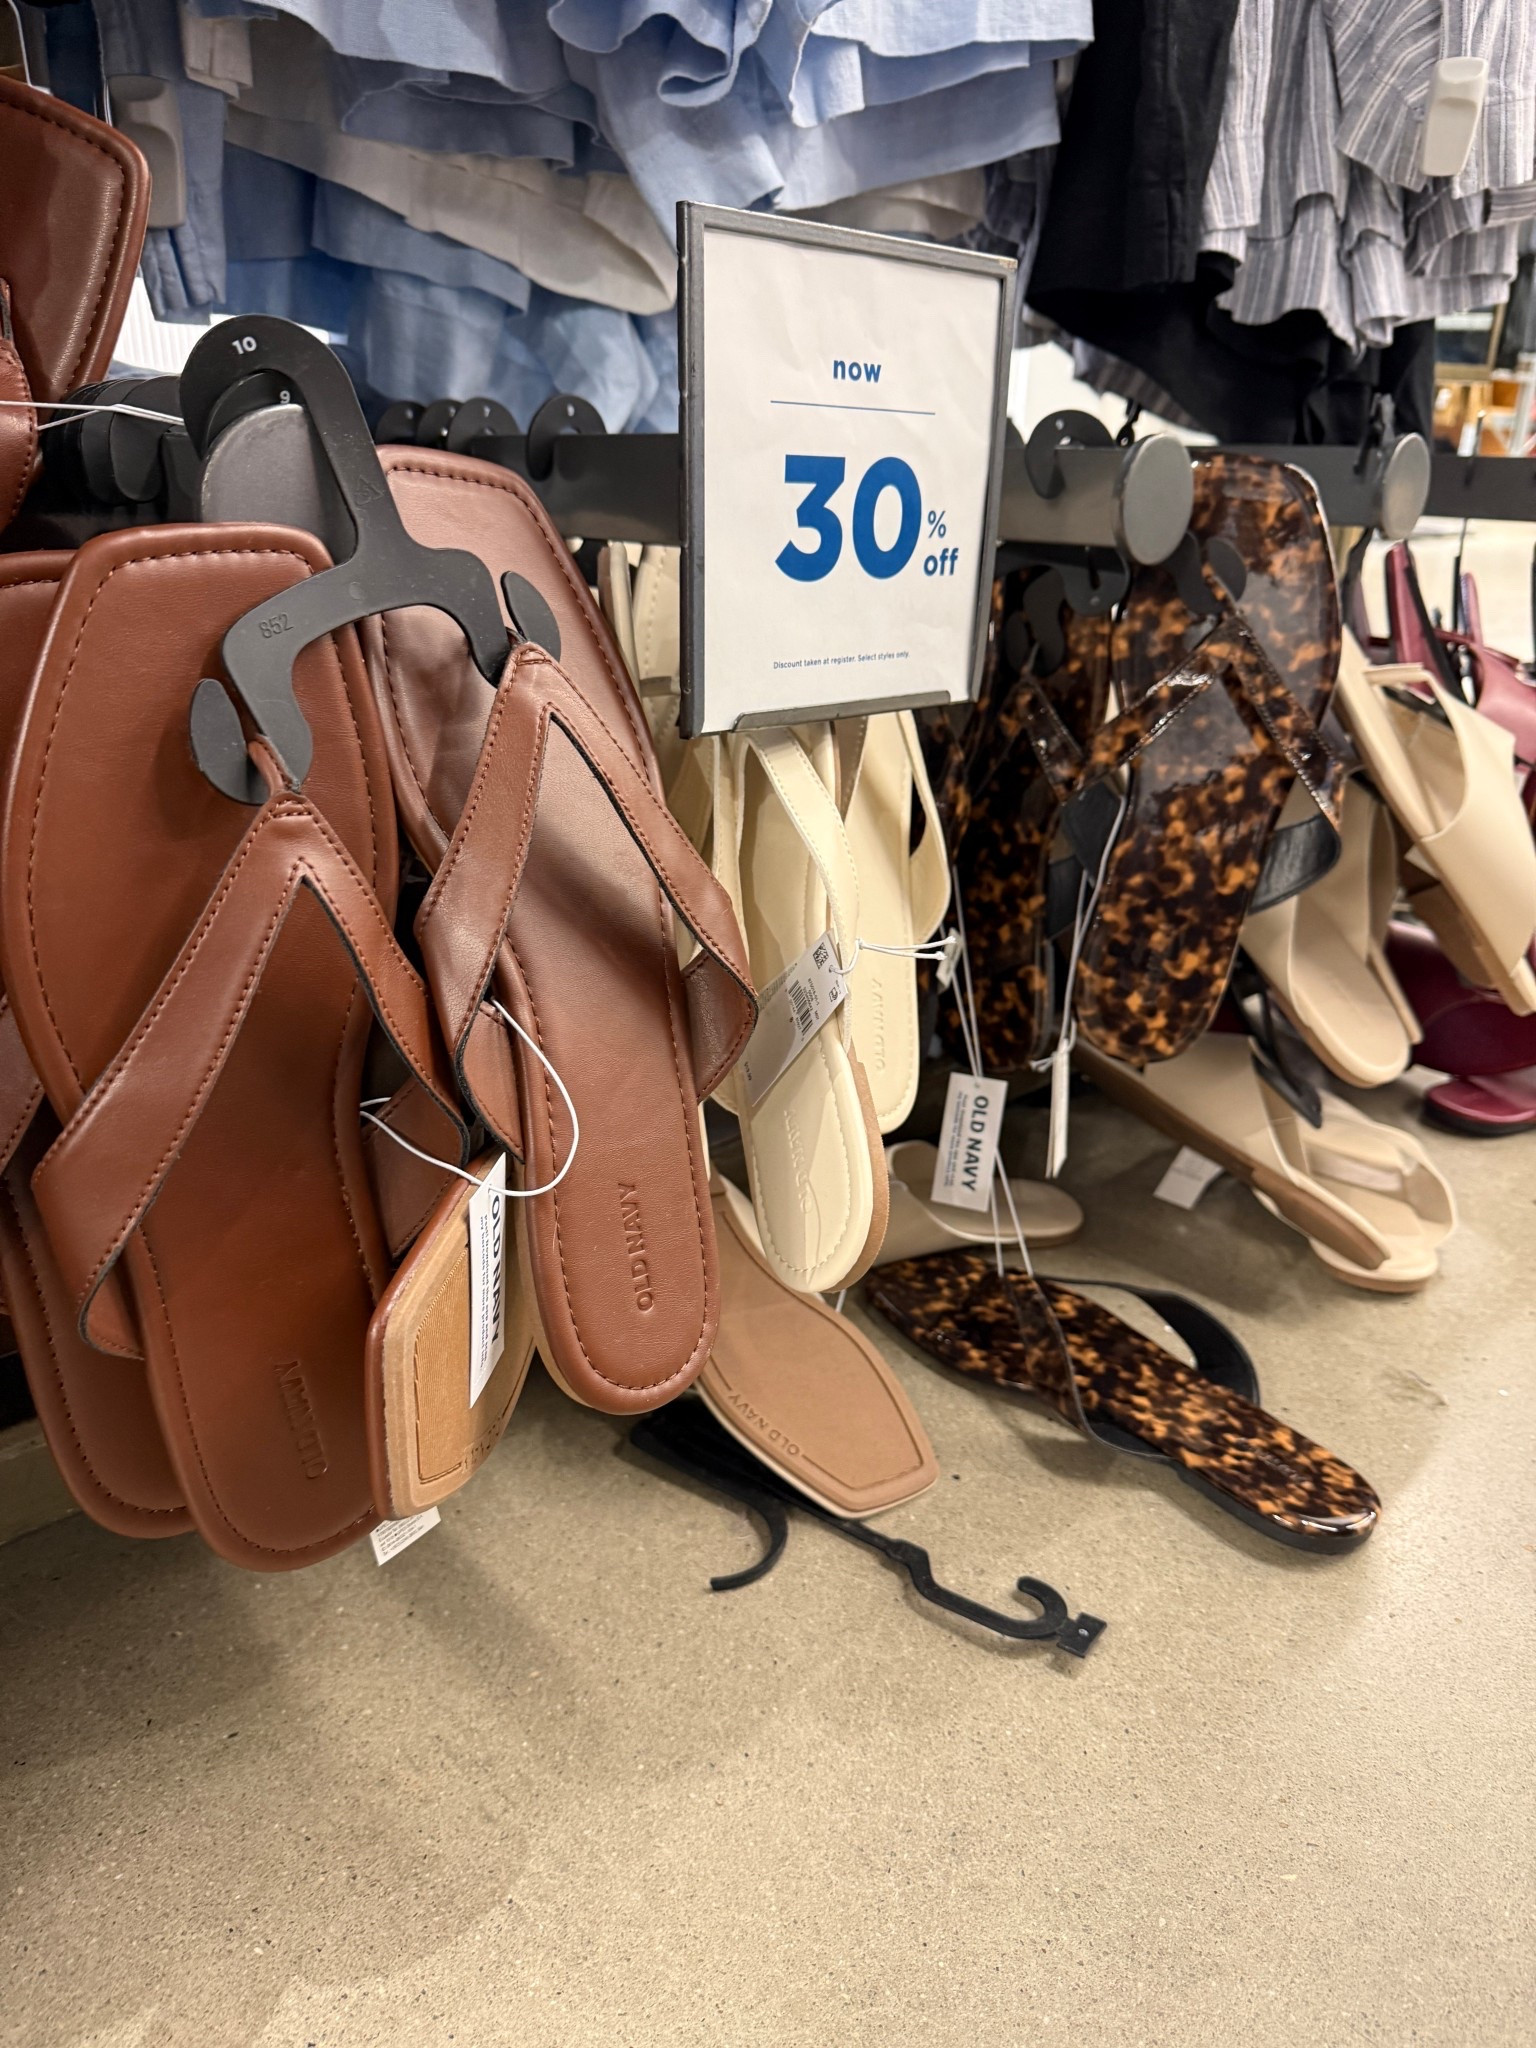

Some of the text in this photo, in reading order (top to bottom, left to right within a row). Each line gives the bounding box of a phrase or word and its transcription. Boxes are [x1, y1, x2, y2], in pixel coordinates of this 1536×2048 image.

[232, 336, 257, 354] 10
[833, 359, 881, 383] now
[279, 390, 290, 404] 9
[775, 454, 947, 583] 30 %
[923, 547, 959, 576] off
[259, 613, 294, 639] 852
[773, 650, 910, 669] Discount taken at register. Select styles only.
[961, 1095, 989, 1192] OLD NAVY
[618, 1182, 654, 1313] OLD NAVY
[491, 1195, 501, 1344] OLD NAVY
[728, 1393, 800, 1456] OLD NAVY
